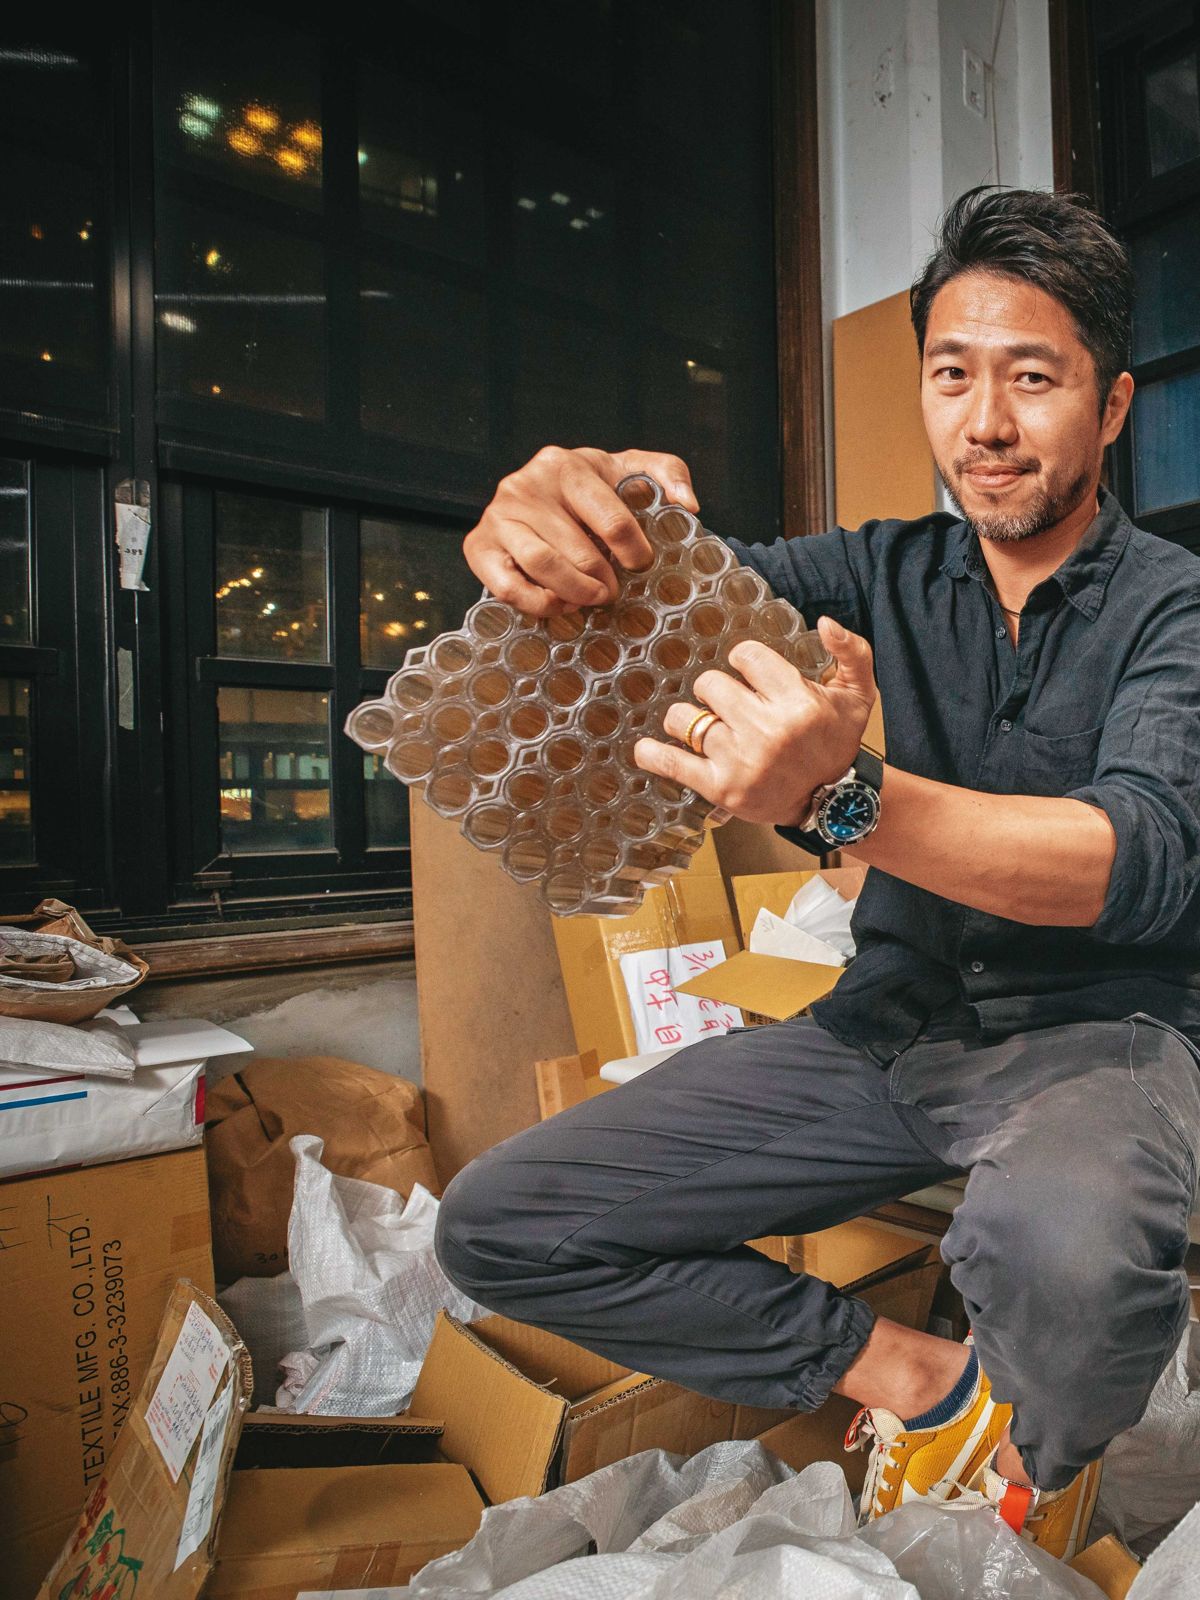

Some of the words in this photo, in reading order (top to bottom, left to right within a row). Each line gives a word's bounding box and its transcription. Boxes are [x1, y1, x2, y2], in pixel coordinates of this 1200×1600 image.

[76, 1322, 100, 1384] MFG.
[102, 1239, 130, 1442] AX:886-3-3239073
[80, 1386, 105, 1486] TEXTILE
